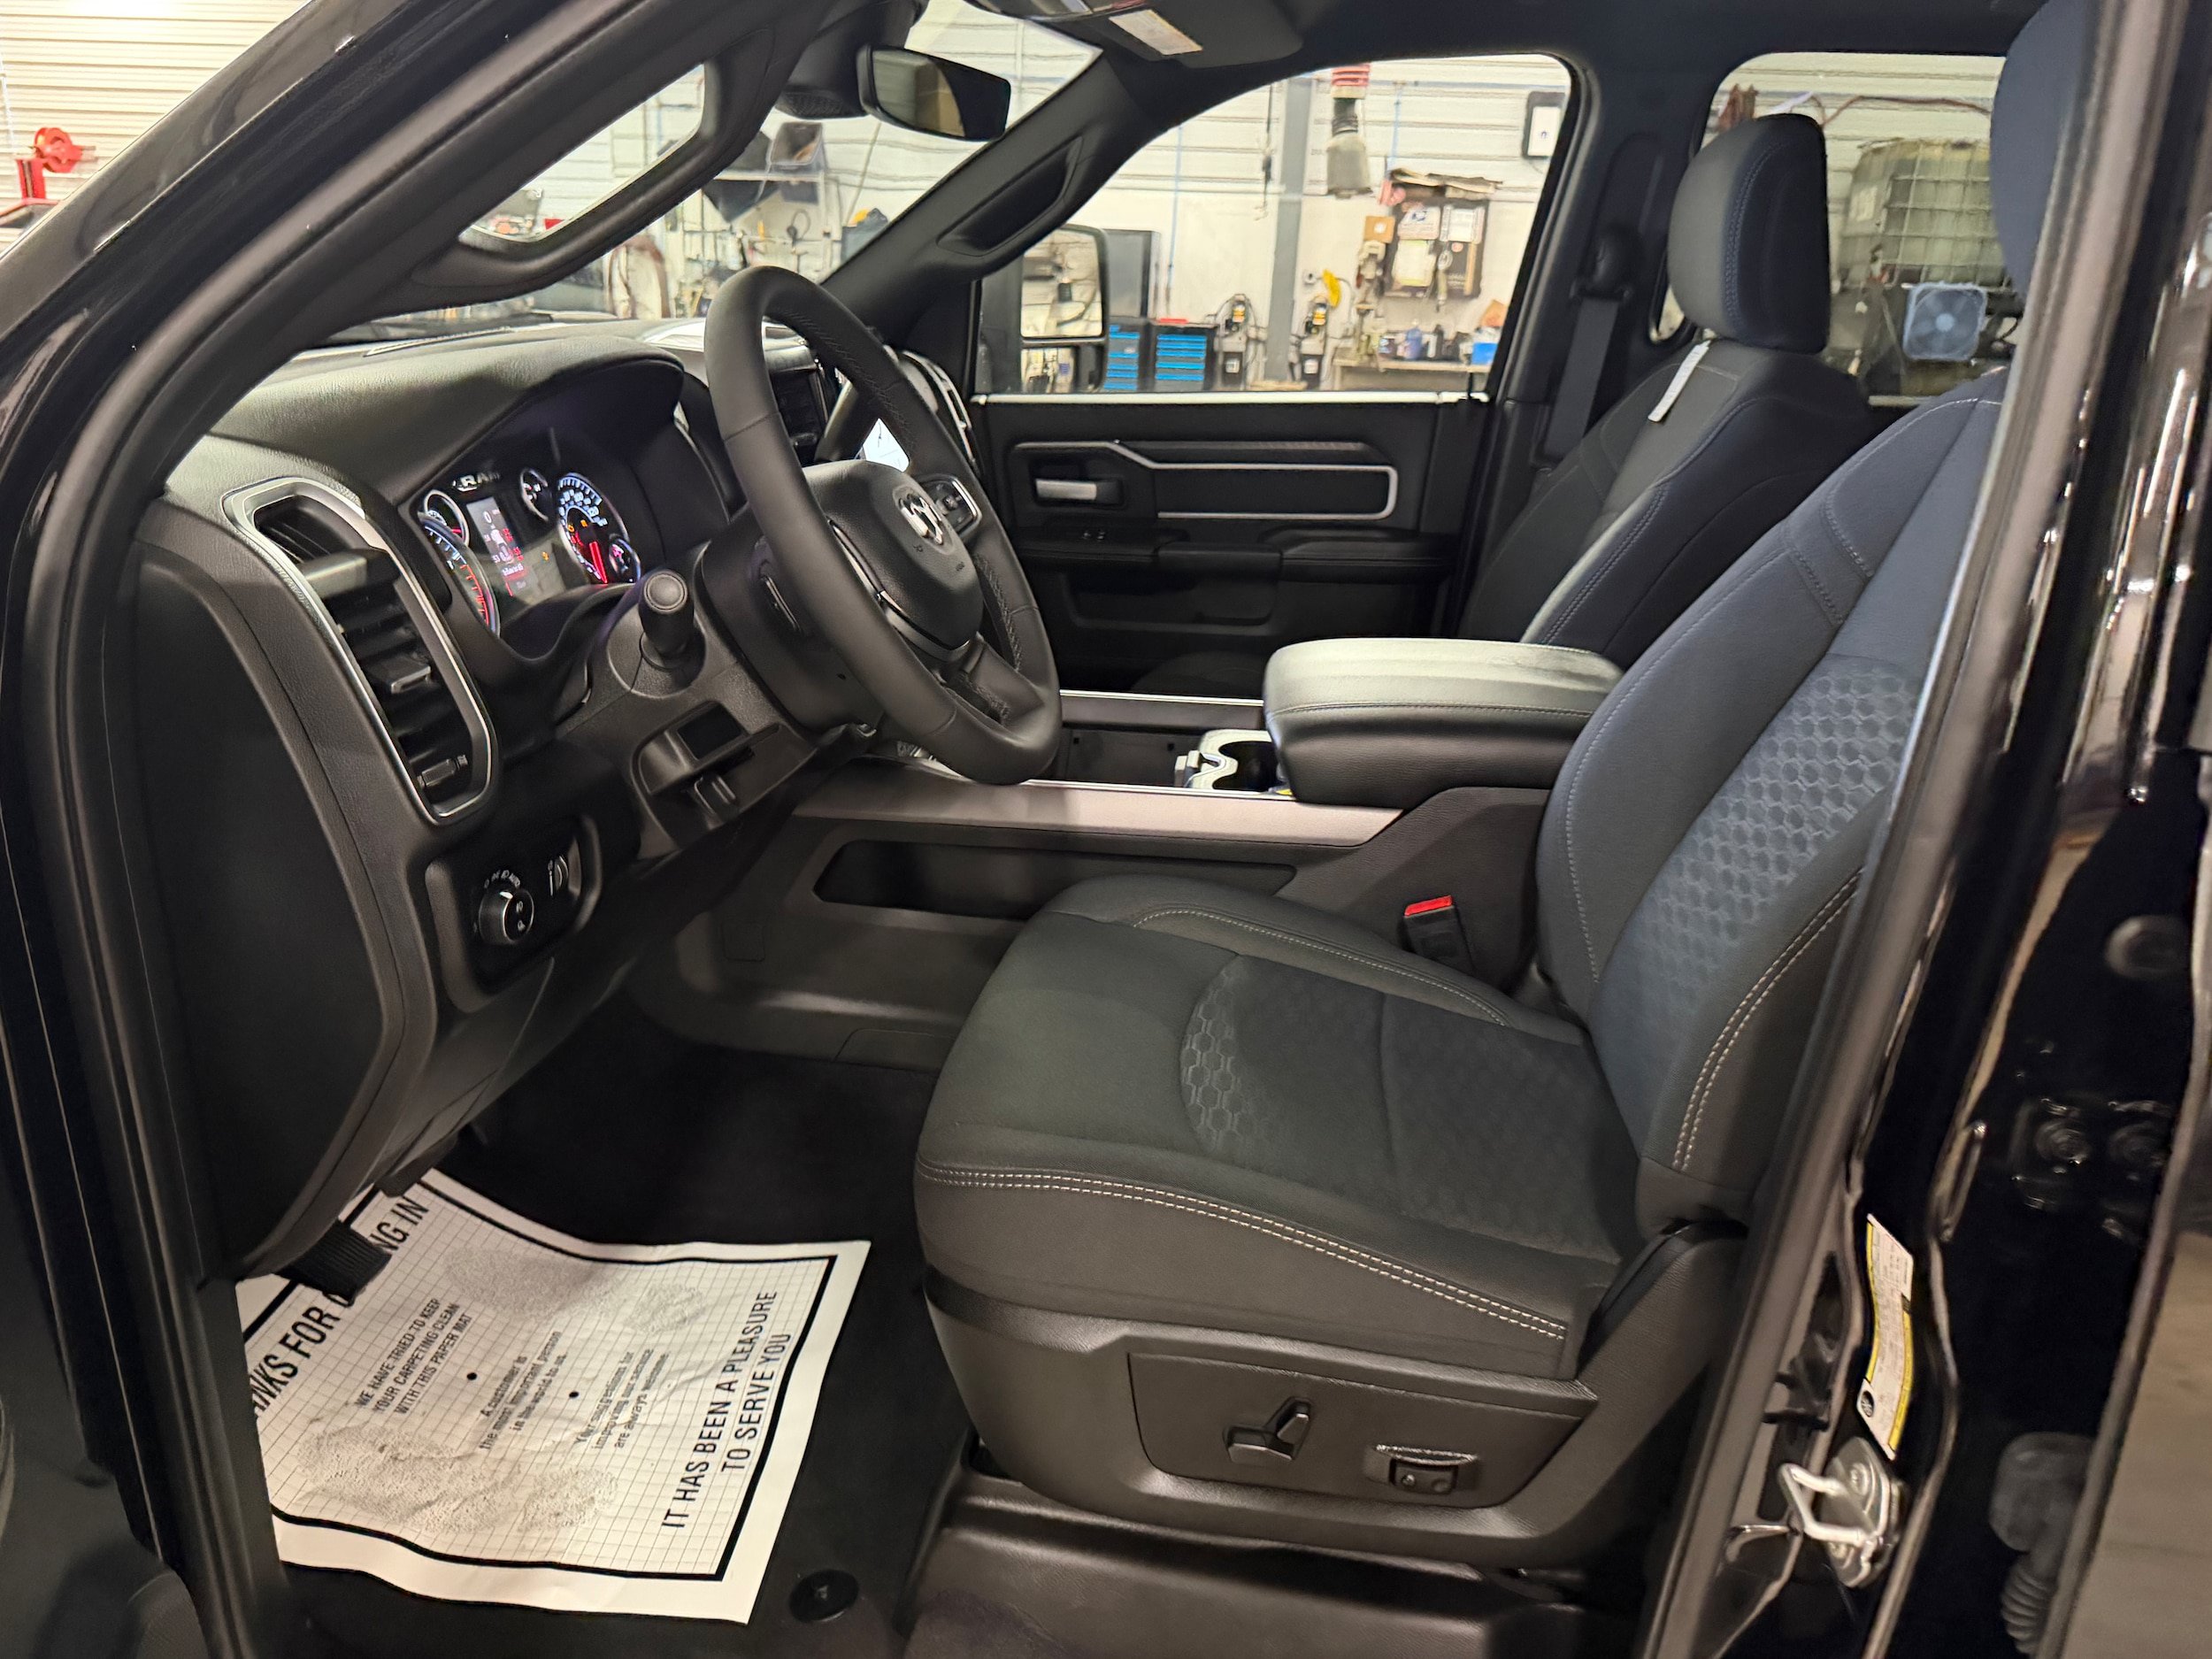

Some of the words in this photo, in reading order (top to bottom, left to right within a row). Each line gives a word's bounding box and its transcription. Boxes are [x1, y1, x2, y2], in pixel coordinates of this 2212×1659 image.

[279, 1306, 342, 1360] FOR
[390, 1195, 429, 1226] IN
[355, 1390, 375, 1407] WE
[367, 1363, 396, 1390] HAVE
[387, 1333, 415, 1362] TRIED
[409, 1318, 426, 1333] TO
[419, 1298, 441, 1320] KEEP
[721, 1291, 778, 1373] PLEASURE
[757, 1333, 791, 1363] YOU
[373, 1386, 401, 1414] YOUR
[393, 1331, 439, 1386] CARPETING
[432, 1302, 461, 1332] CLEAN
[394, 1388, 420, 1414] WITH
[411, 1364, 437, 1389] THIS
[430, 1332, 459, 1364] PAPER
[452, 1313, 472, 1333] MAT
[716, 1379, 739, 1393] A
[734, 1371, 774, 1440] SERVE
[479, 1432, 497, 1449] the
[509, 1420, 525, 1431] in
[614, 1432, 631, 1449] are
[693, 1401, 732, 1454] BEEN
[721, 1448, 751, 1472] TO
[672, 1461, 709, 1502] HAS
[662, 1509, 689, 1528] IT
